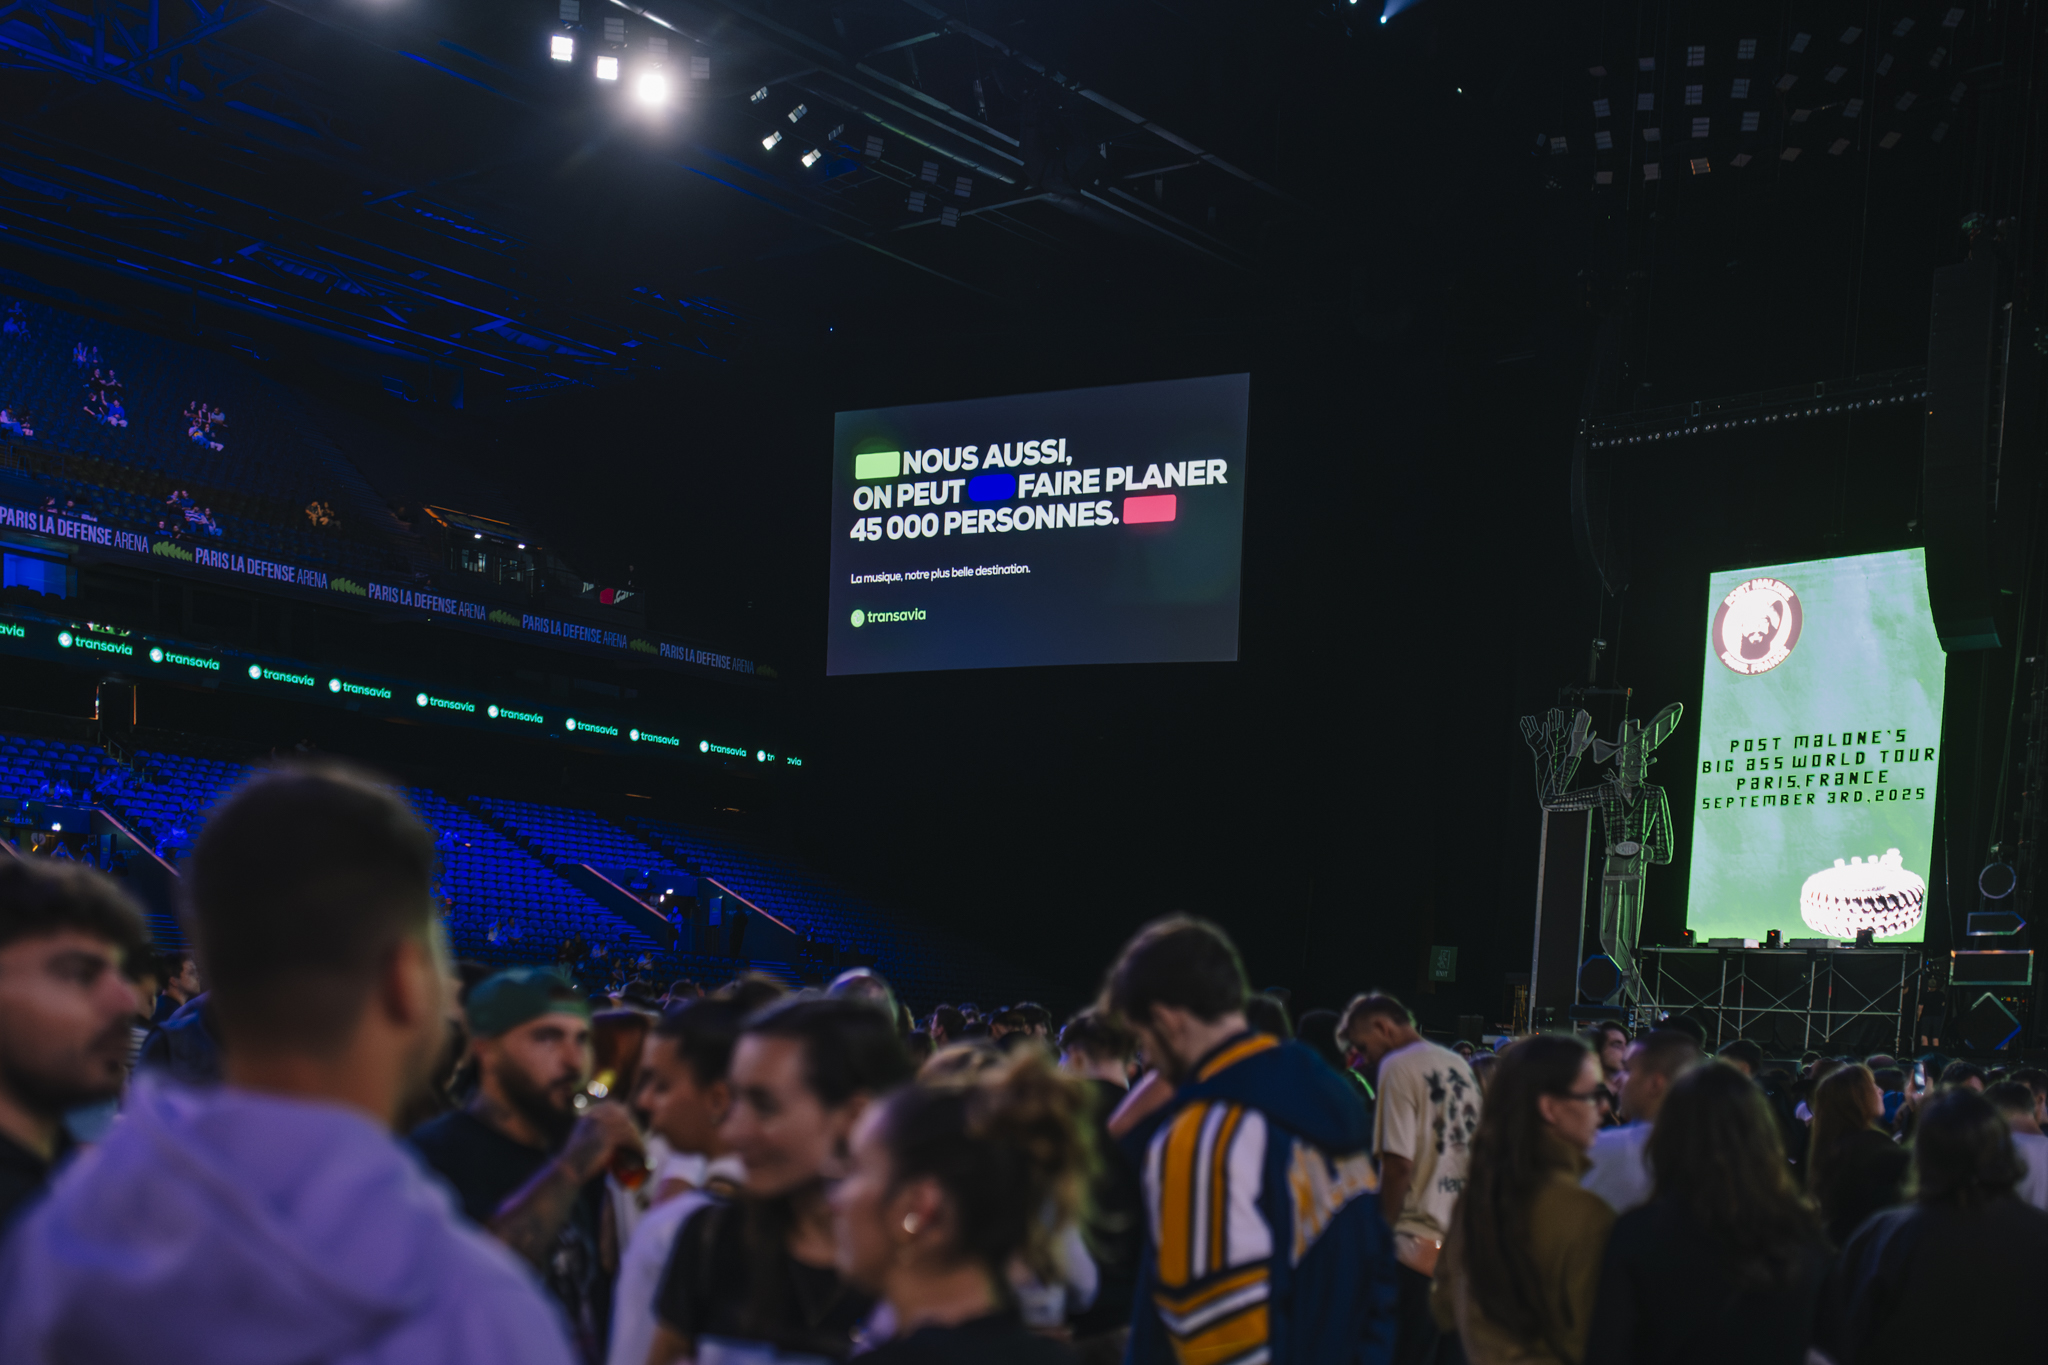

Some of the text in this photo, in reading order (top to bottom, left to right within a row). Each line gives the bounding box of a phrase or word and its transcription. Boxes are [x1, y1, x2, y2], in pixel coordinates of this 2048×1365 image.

[903, 438, 1072, 475] NOUS AUSSI,
[854, 459, 1227, 510] ON PEUT FAIRE PLANER
[0, 506, 148, 553] PARIS LA DEFENSE ARENA
[850, 501, 1119, 541] 45 000 PERSONNES.
[195, 548, 327, 589] PARIS LA DEFENSE ARENA
[851, 564, 1030, 584] La musique, notre plus belle destination.
[368, 583, 485, 620] PARIS LA DEFENSE ARENA
[867, 608, 926, 623] transavia
[523, 614, 627, 648] PARIS LA DEFENSE ARENA
[75, 635, 133, 656] transavia
[165, 652, 220, 670] transavia
[660, 643, 684, 660] PARIS
[685, 648, 695, 662] LA
[697, 650, 730, 669] DEFENSE
[263, 669, 314, 686] transavia
[343, 682, 391, 698] transavia
[430, 697, 475, 712] transavia
[500, 708, 543, 723] transavia
[578, 721, 618, 736] transavia
[641, 732, 679, 746] transavia
[1731, 738, 1780, 752] POST
[710, 744, 746, 757] transavia
[1703, 748, 1934, 773] BIG ASS WORLD TOUR
[1703, 794, 1814, 809] SEPTEMBER
